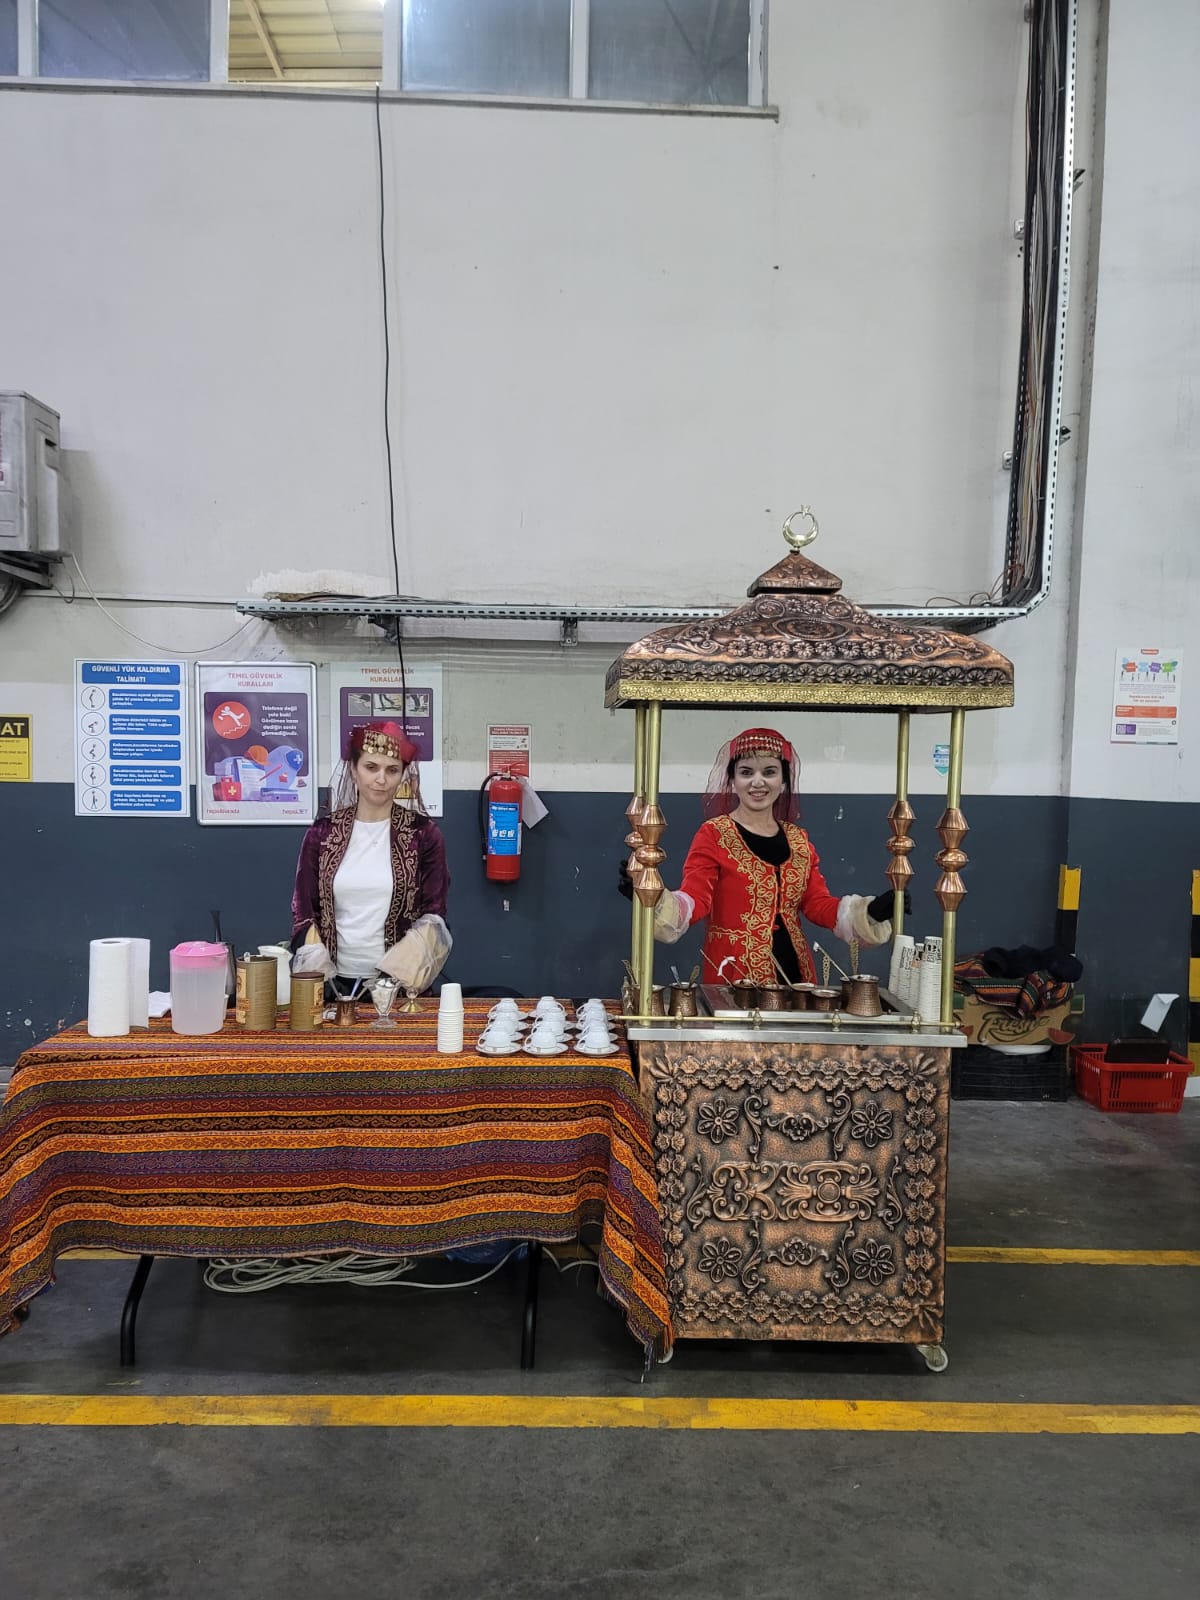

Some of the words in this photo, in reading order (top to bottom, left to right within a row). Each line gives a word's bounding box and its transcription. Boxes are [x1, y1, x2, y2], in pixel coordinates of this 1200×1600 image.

[92, 665, 120, 673] GÜVENLİ
[121, 665, 135, 673] YÜK
[136, 665, 170, 674] KALDIRMA
[116, 675, 146, 683] TALİMATI
[249, 671, 283, 679] GÜVENLİK
